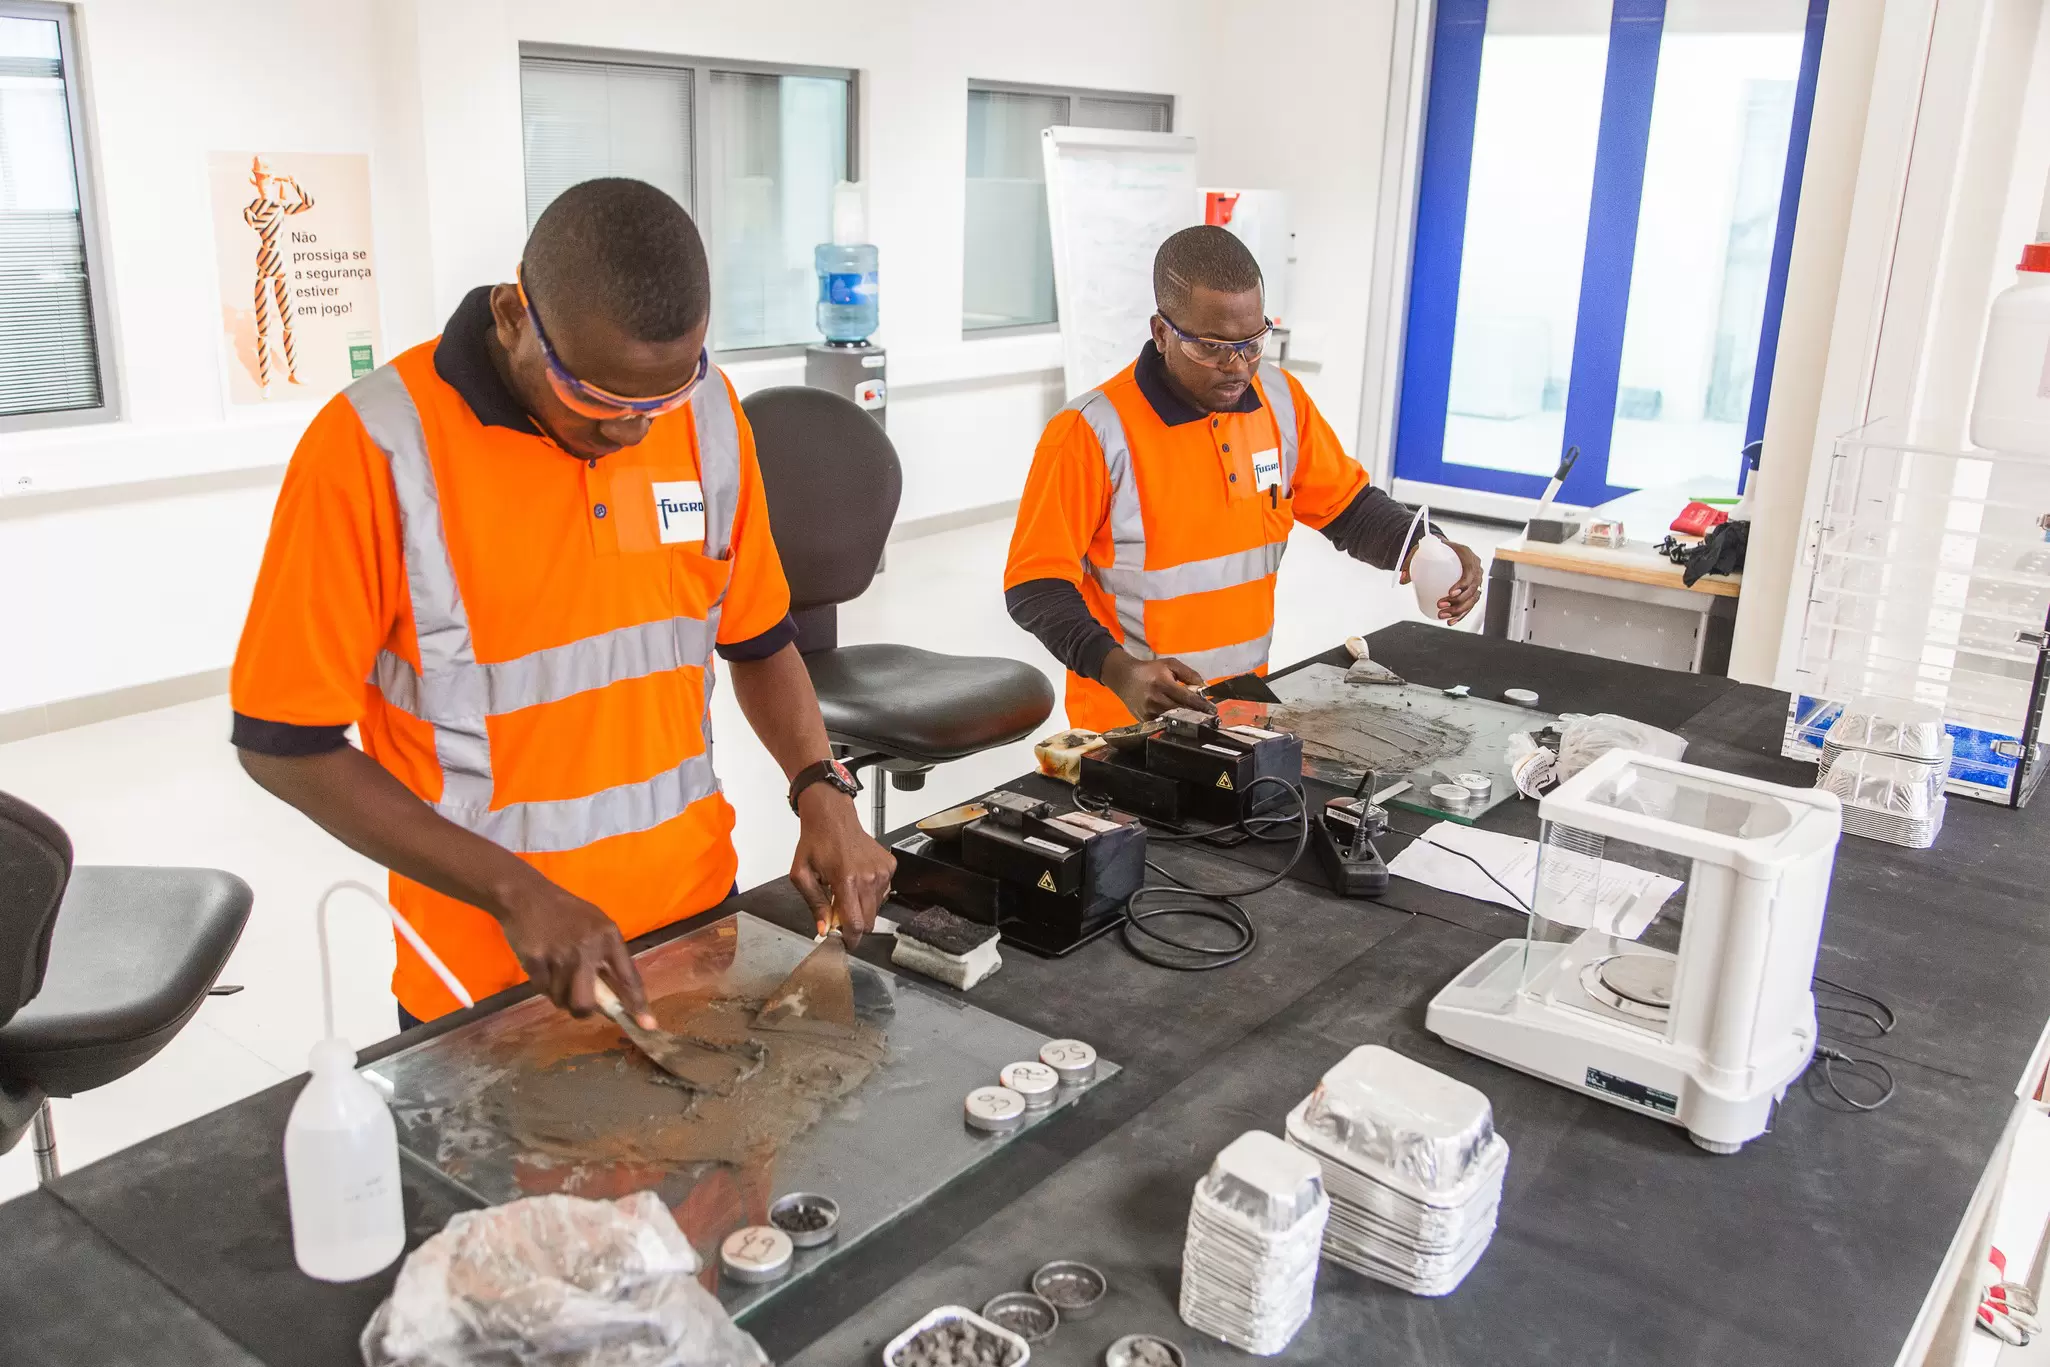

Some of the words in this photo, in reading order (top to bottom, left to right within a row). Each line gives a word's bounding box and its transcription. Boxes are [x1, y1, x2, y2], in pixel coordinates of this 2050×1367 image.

[291, 231, 317, 244] Não
[293, 249, 349, 265] prossiga
[352, 250, 367, 260] se
[294, 270, 302, 280] a
[306, 268, 372, 281] segurança
[296, 285, 339, 298] estiver
[298, 306, 317, 316] em
[321, 301, 353, 318] jogo!
